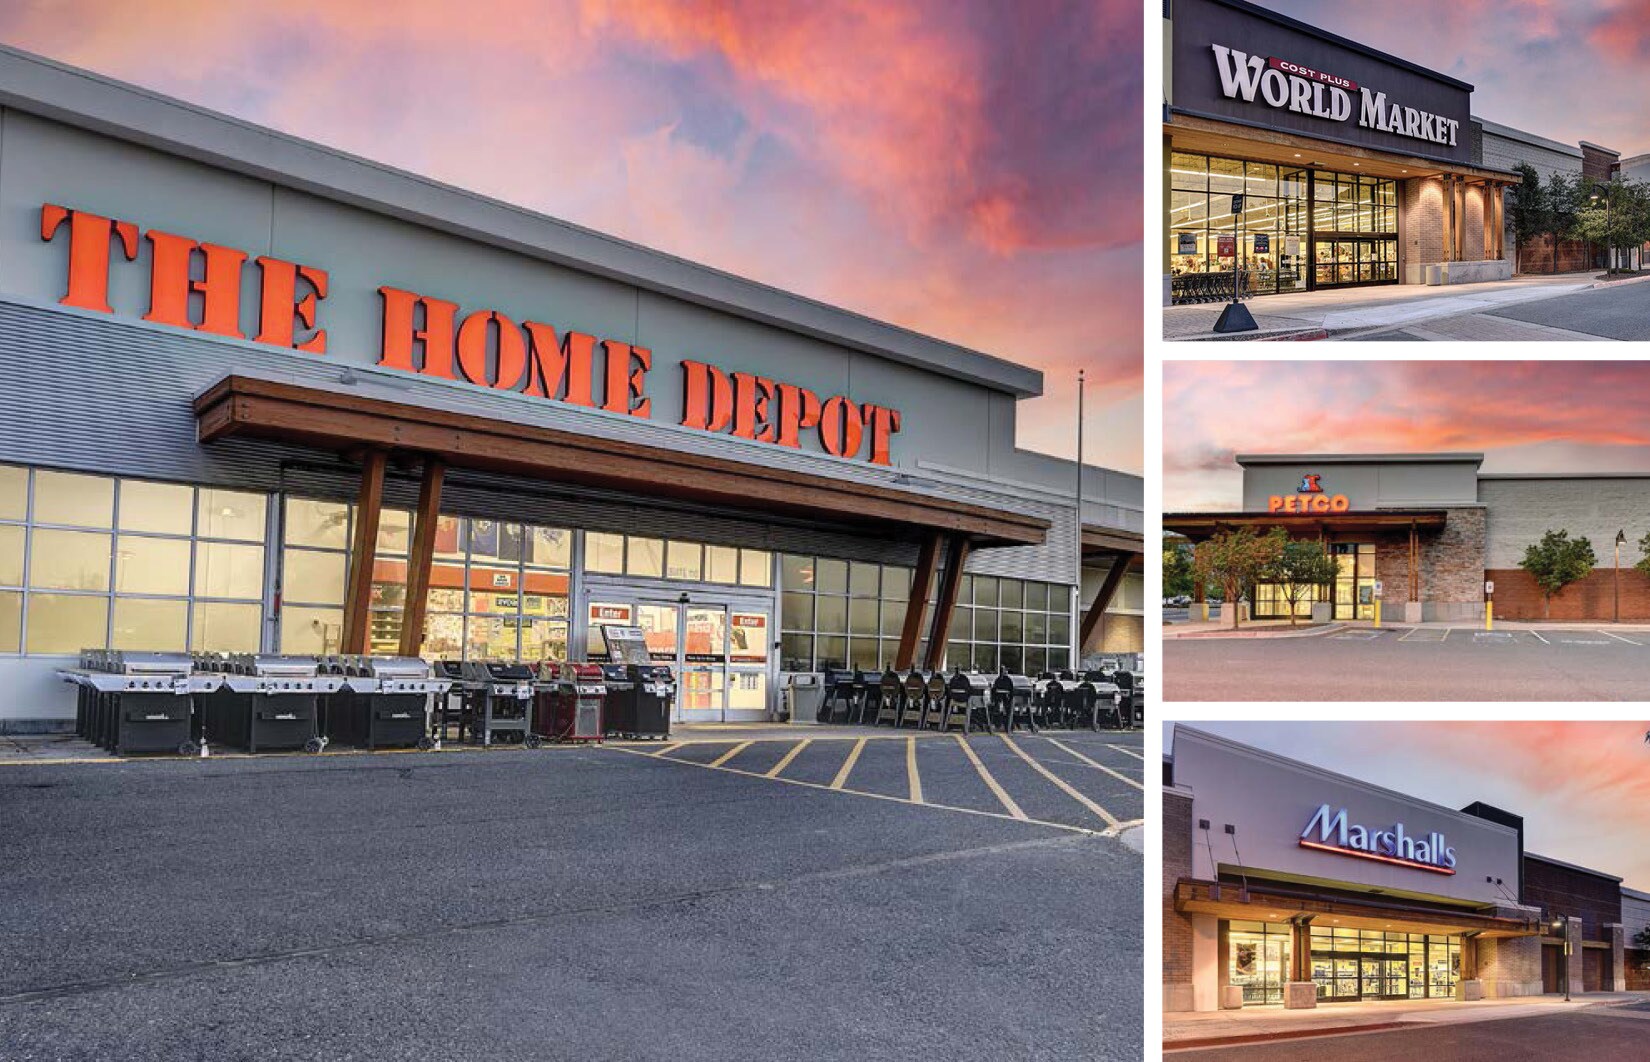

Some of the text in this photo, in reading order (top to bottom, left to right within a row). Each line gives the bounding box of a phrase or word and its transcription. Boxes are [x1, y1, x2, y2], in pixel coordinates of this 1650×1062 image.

[1211, 43, 1459, 147] WORLD MARKET
[1280, 61, 1350, 87] COST PLUS
[40, 202, 900, 467] THE HOME DEPOT
[1268, 493, 1350, 514] PETCO
[1300, 803, 1457, 868] Marshalls
